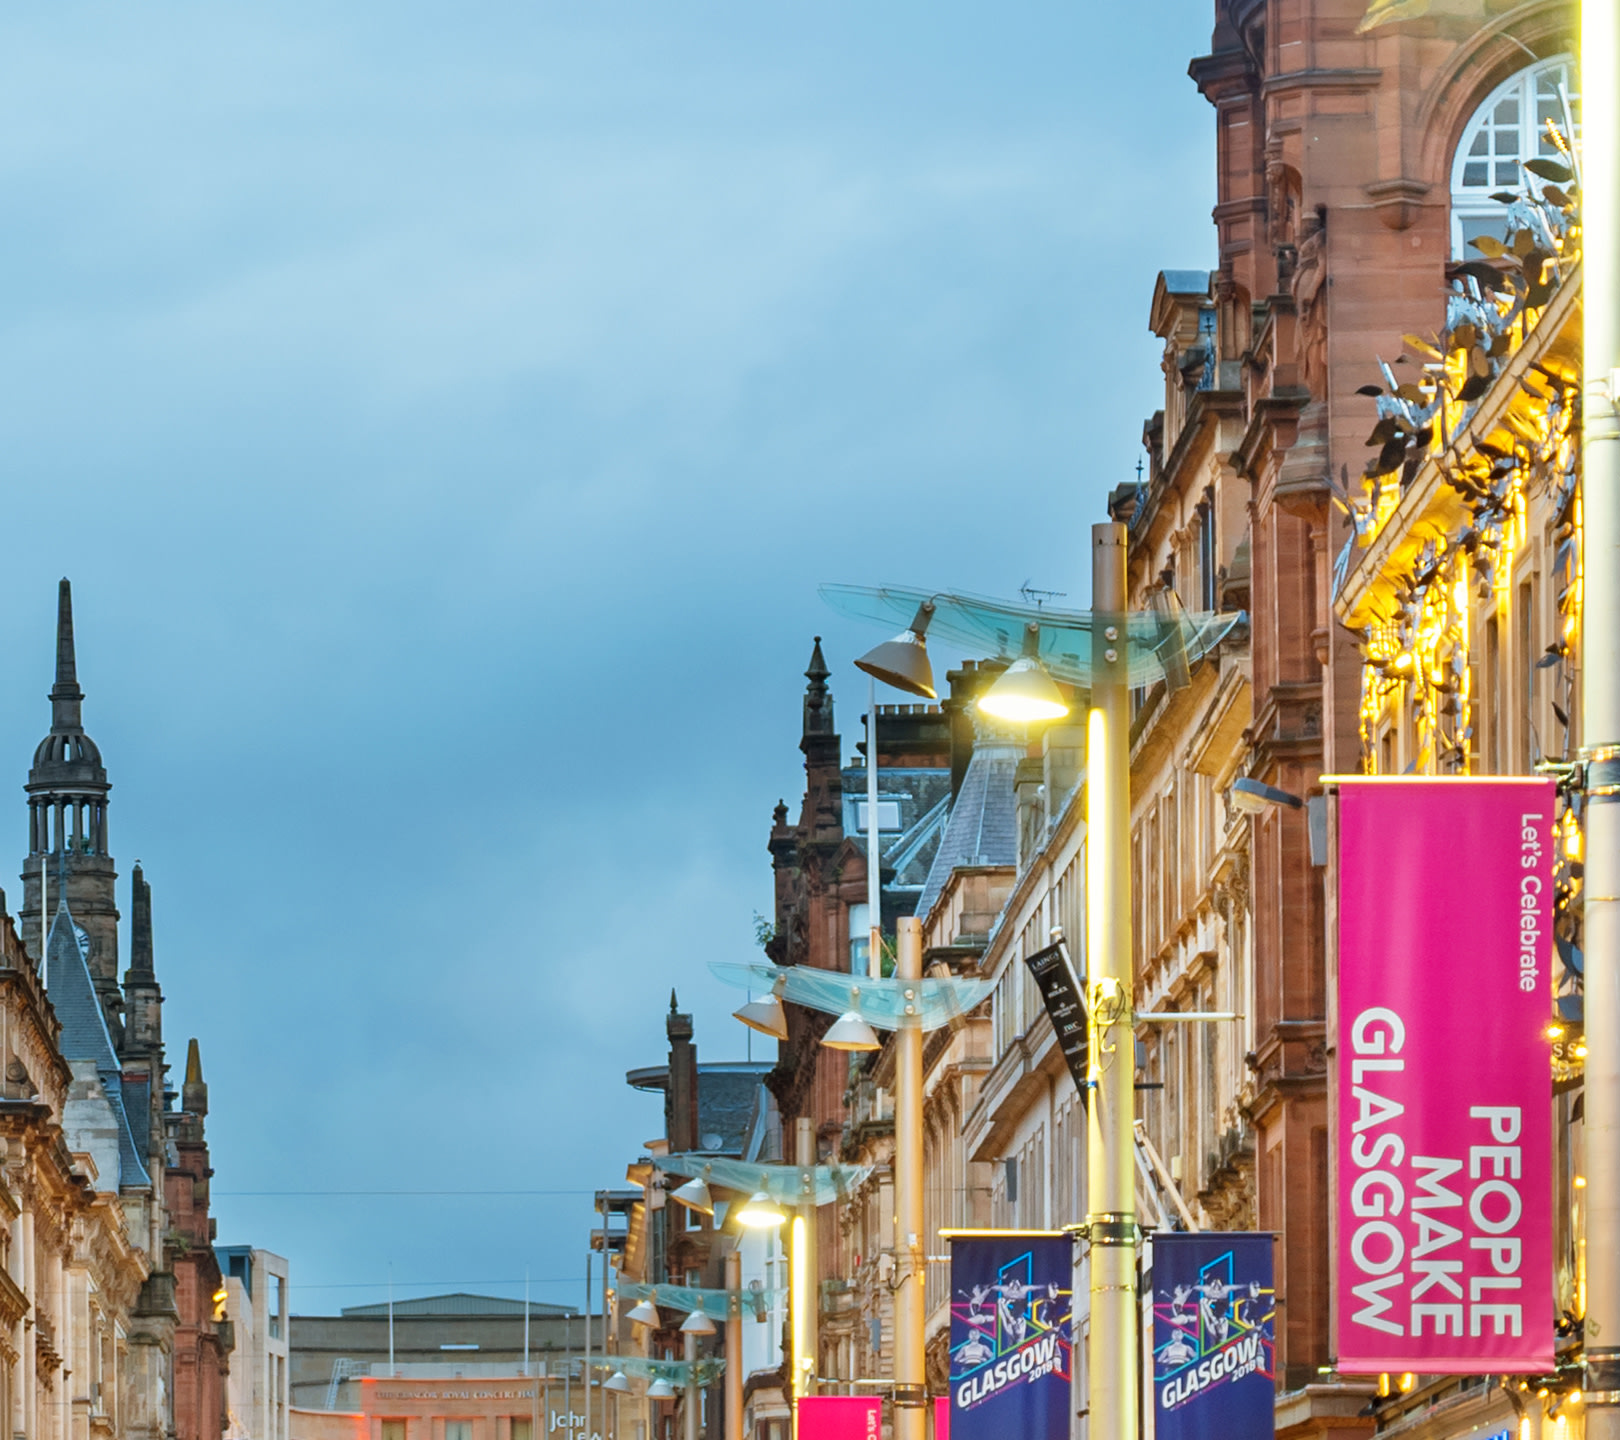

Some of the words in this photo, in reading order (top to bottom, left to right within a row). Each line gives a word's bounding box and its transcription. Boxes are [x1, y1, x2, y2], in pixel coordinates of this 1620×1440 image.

[1521, 812, 1543, 868] Let's
[1520, 875, 1542, 993] Celebrate
[1350, 1006, 1406, 1337] GLASGOW
[1410, 1155, 1464, 1337] MAKE
[1469, 1105, 1522, 1337] PEOPLE
[957, 1334, 1056, 1409] GLASGOW
[1028, 1363, 1053, 1384] 2018
[1161, 1333, 1258, 1409] GLASGOW
[1231, 1362, 1256, 1383] 2018
[867, 1409, 877, 1431] Let's
